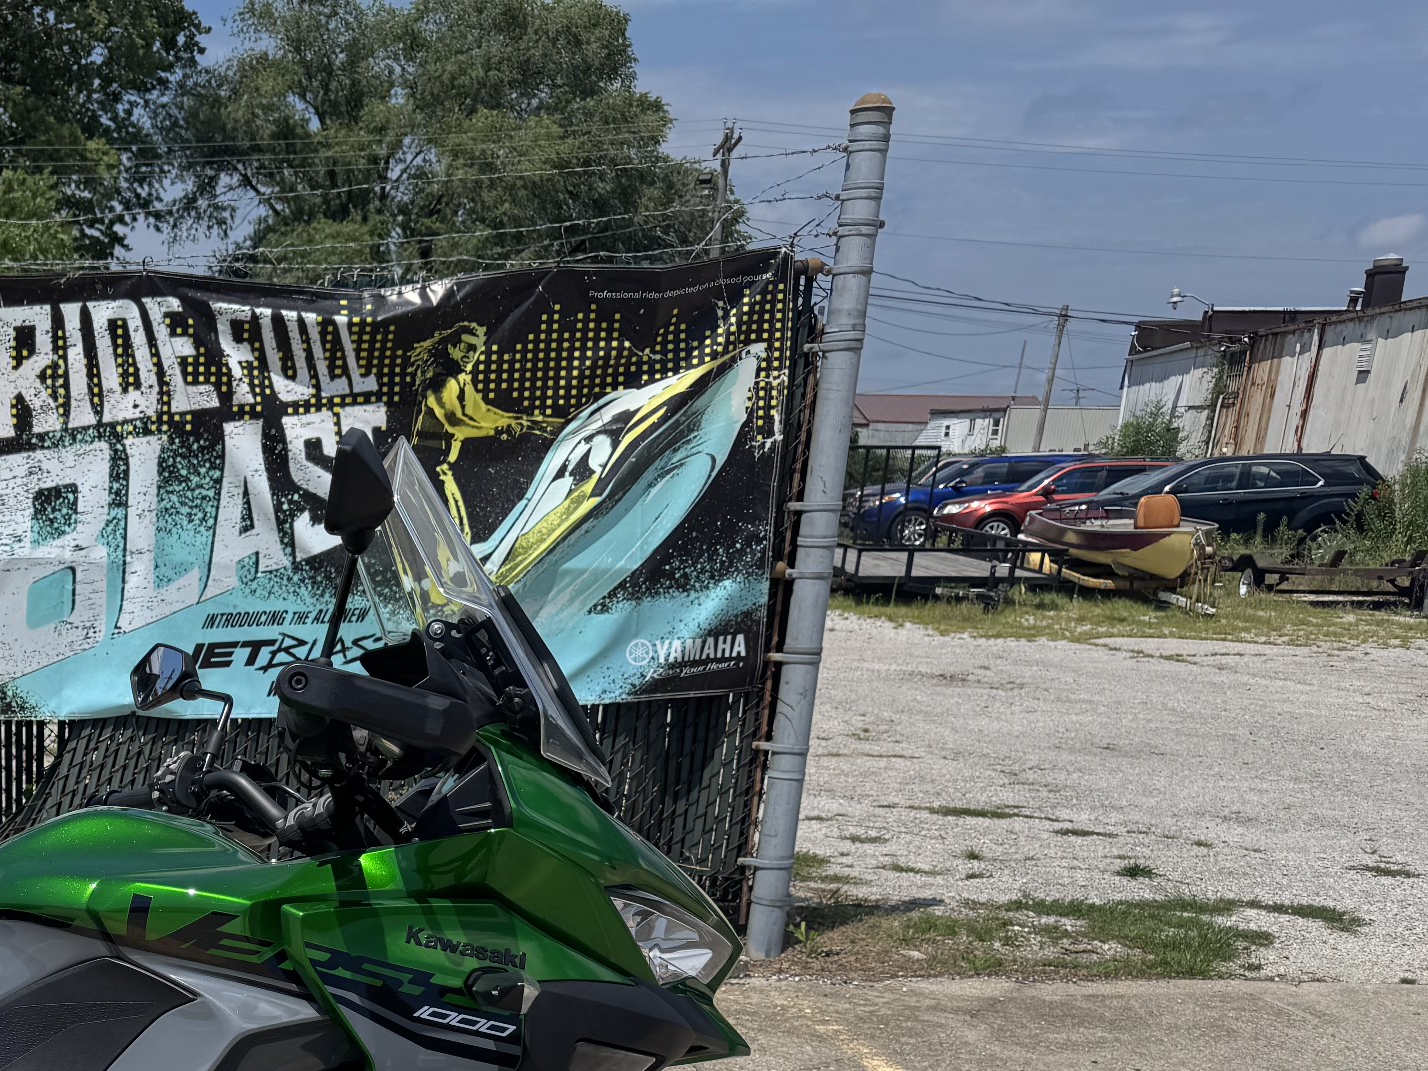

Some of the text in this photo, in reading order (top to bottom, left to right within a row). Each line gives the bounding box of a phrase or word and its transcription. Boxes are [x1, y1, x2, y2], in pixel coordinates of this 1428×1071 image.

[589, 289, 642, 300] Professional
[642, 290, 663, 299] rider
[663, 283, 700, 298] depicted
[715, 274, 742, 287] closed
[208, 301, 379, 404] FULL
[201, 610, 291, 630] INTRODUCING
[288, 611, 312, 627] THE
[655, 634, 746, 665] YAMAHA
[681, 665, 706, 678] Your
[706, 661, 736, 671] Heart
[405, 924, 527, 970] Kawasaki
[413, 1005, 517, 1037] 1000
